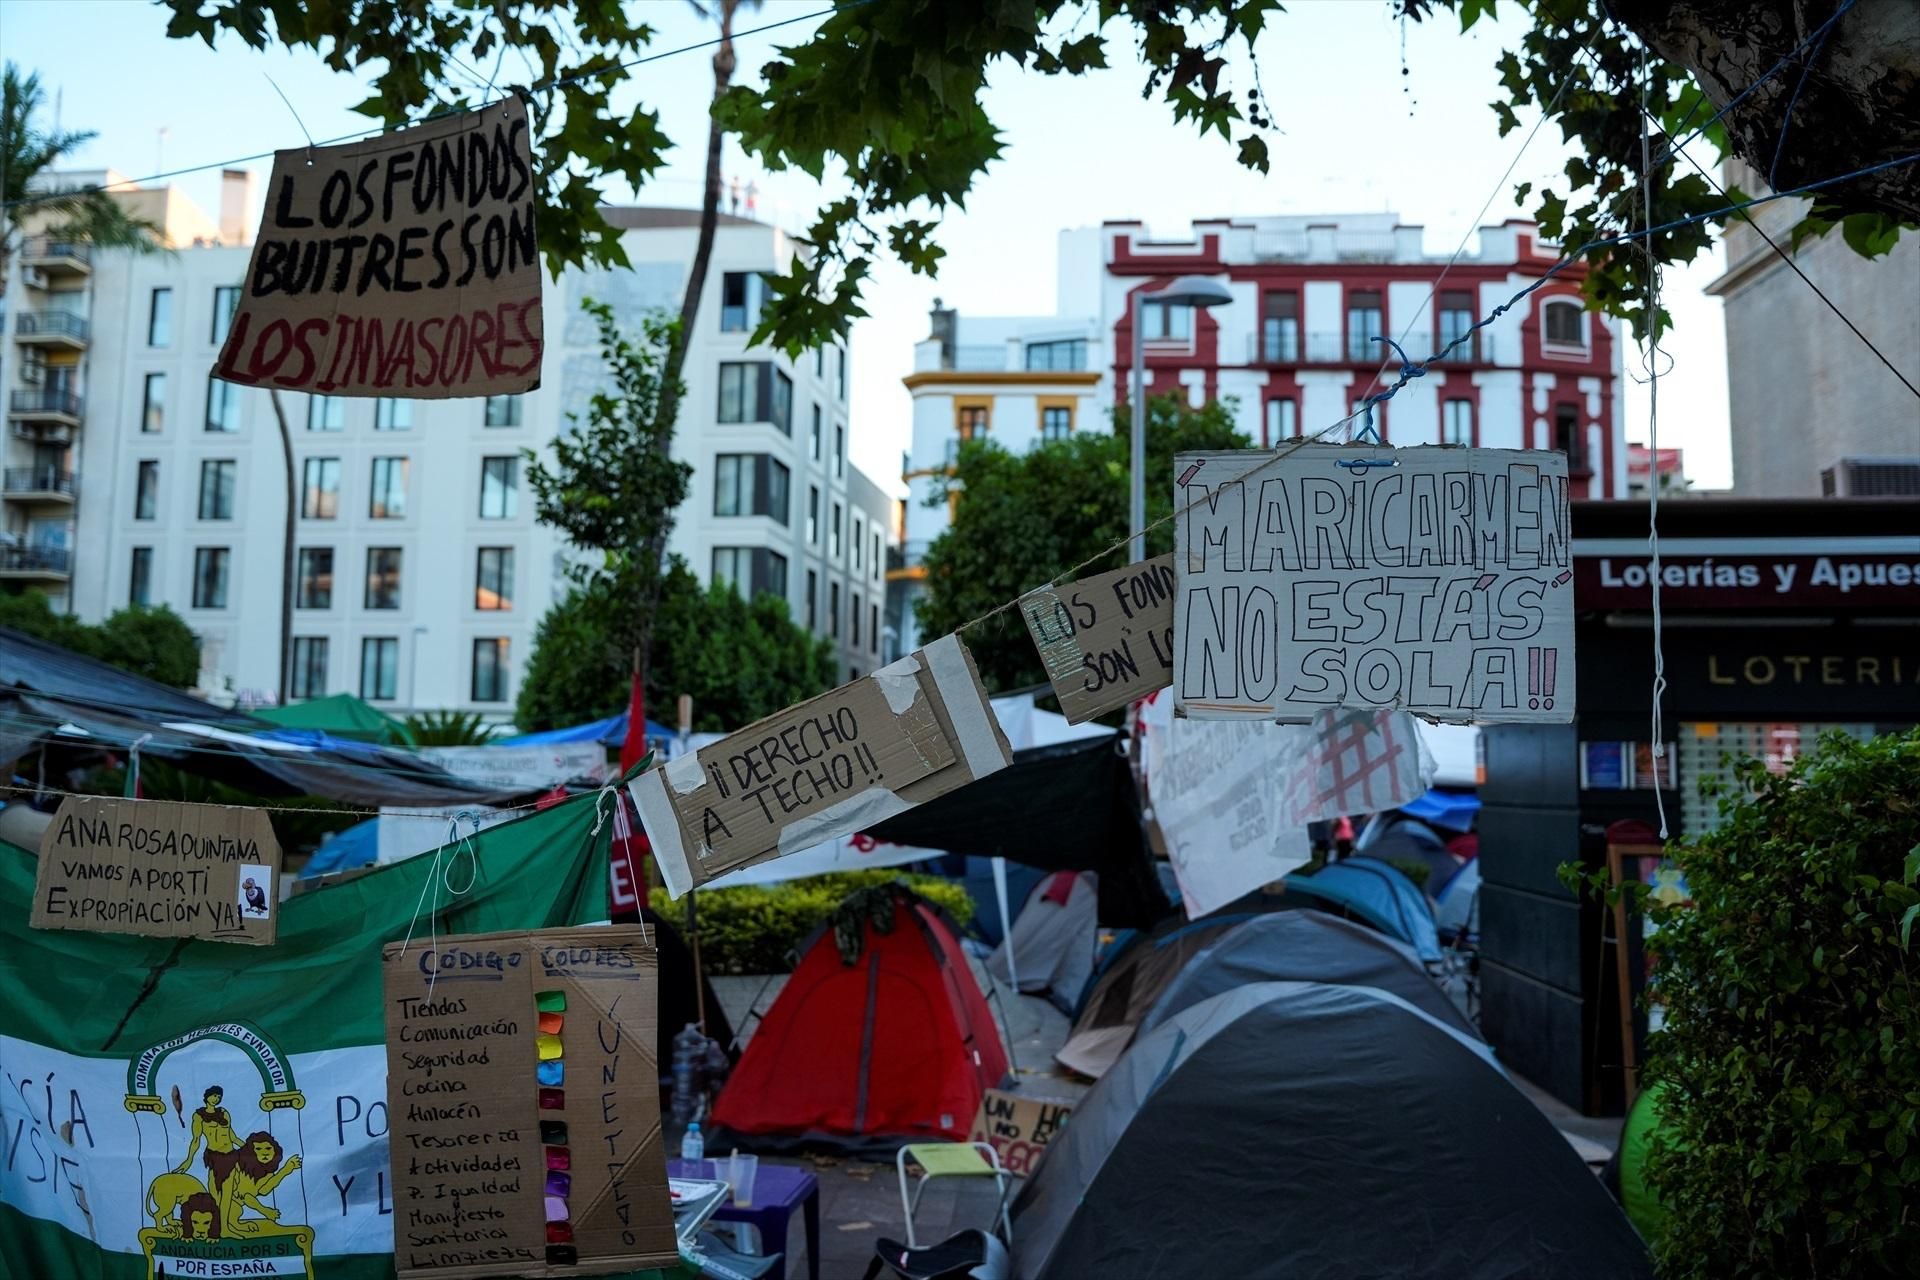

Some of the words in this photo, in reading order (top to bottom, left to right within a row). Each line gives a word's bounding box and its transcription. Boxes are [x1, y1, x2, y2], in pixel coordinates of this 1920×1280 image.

[276, 159, 379, 229] LOS
[383, 118, 529, 223] FONDOS
[251, 219, 454, 297] BUITRES
[456, 201, 538, 288] SON
[219, 311, 330, 387] LOS
[316, 297, 541, 391] INVASORES
[1600, 557, 1762, 588] Loterías
[1773, 563, 1798, 593] y
[1032, 592, 1097, 645] LOS
[1182, 586, 1278, 703] NO
[1291, 574, 1547, 645] ESTÁS
[1083, 637, 1140, 692] SON
[1284, 647, 1558, 711] SOLA!!
[1708, 655, 1920, 686] LOTERI
[57, 814, 112, 849] ANA
[117, 823, 184, 856] ROSA
[179, 833, 261, 864] QUINTANA
[701, 806, 733, 850] A
[61, 860, 125, 881] VAMOS
[129, 868, 143, 889] A
[147, 871, 185, 895] POR
[207, 900, 246, 931] YA!
[397, 997, 467, 1020] Tiendas
[399, 1018, 518, 1043] Comunicación
[136, 1037, 184, 1089] DOMINATOR
[242, 1032, 285, 1087] FVNDATOR
[402, 1046, 490, 1077] Seguridad
[402, 1079, 467, 1097] Cocina
[407, 1102, 481, 1122] Almacén
[984, 1095, 1016, 1121] UN
[408, 1155, 521, 1175] Actividades
[332, 1172, 355, 1217] Y
[434, 1176, 521, 1205] Igualdad
[409, 1206, 505, 1228] Manifiesto
[161, 1244, 236, 1259] ANDALUCIA
[240, 1244, 271, 1256] POR
[275, 1242, 289, 1255] SI
[409, 1247, 537, 1269] Limpieza
[176, 1259, 206, 1276] POR
[211, 1259, 277, 1276] ESPAÑA
